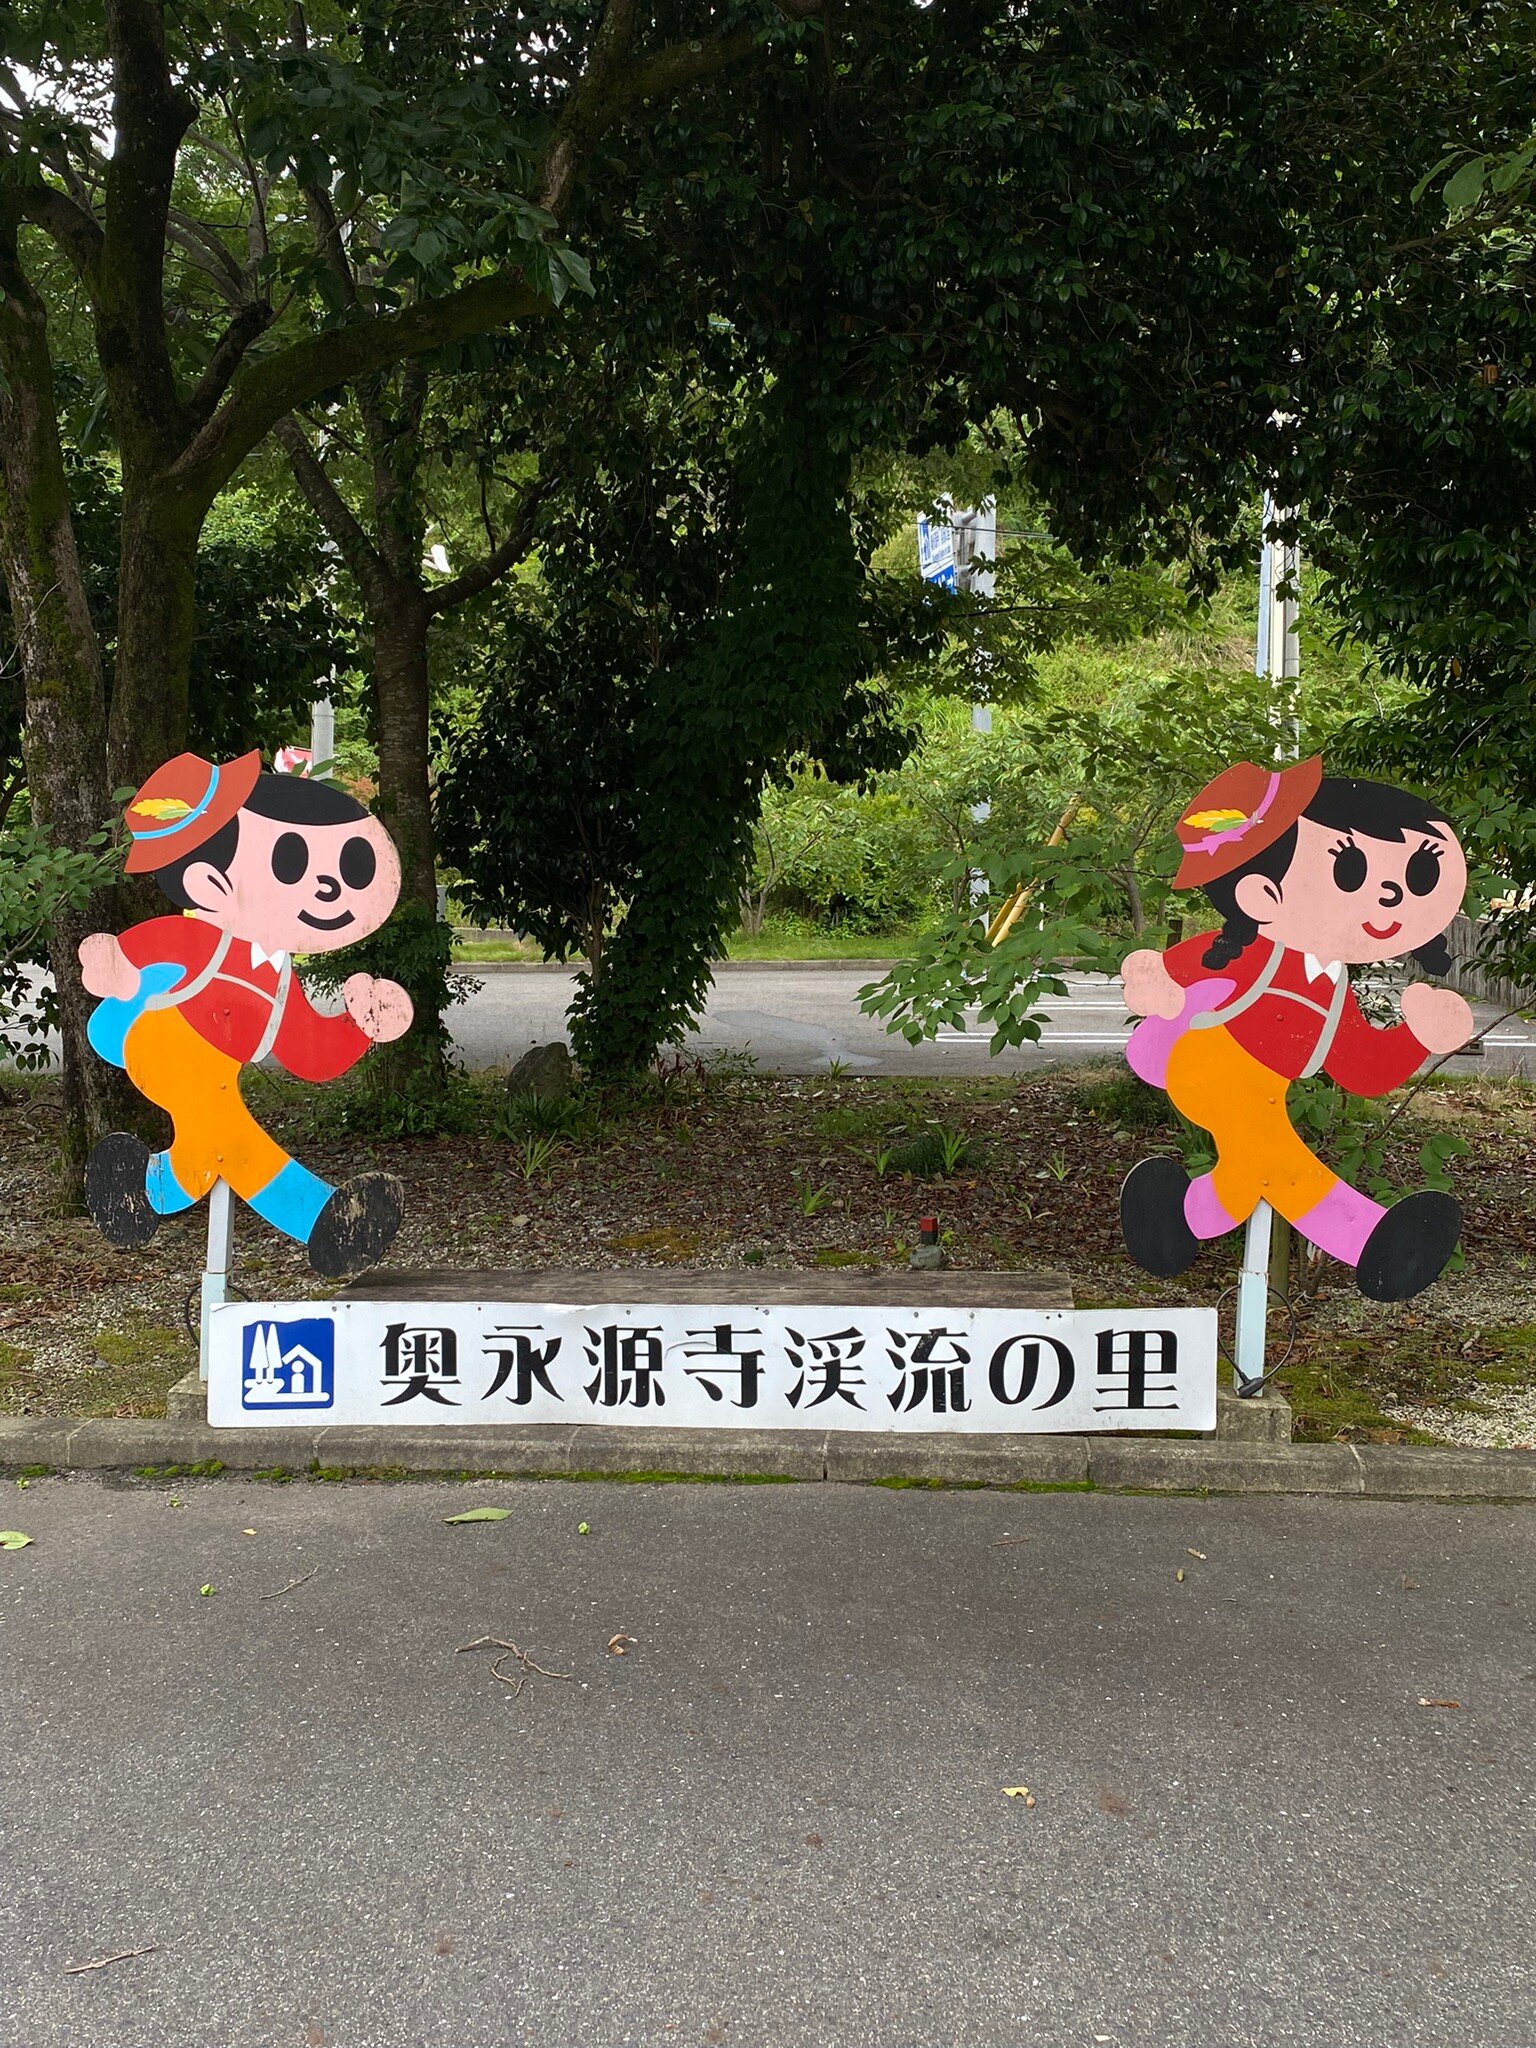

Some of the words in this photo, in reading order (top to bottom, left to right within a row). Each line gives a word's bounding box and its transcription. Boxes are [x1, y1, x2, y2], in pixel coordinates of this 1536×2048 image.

[379, 1322, 1180, 1413] 奥永源寺渓流の里
